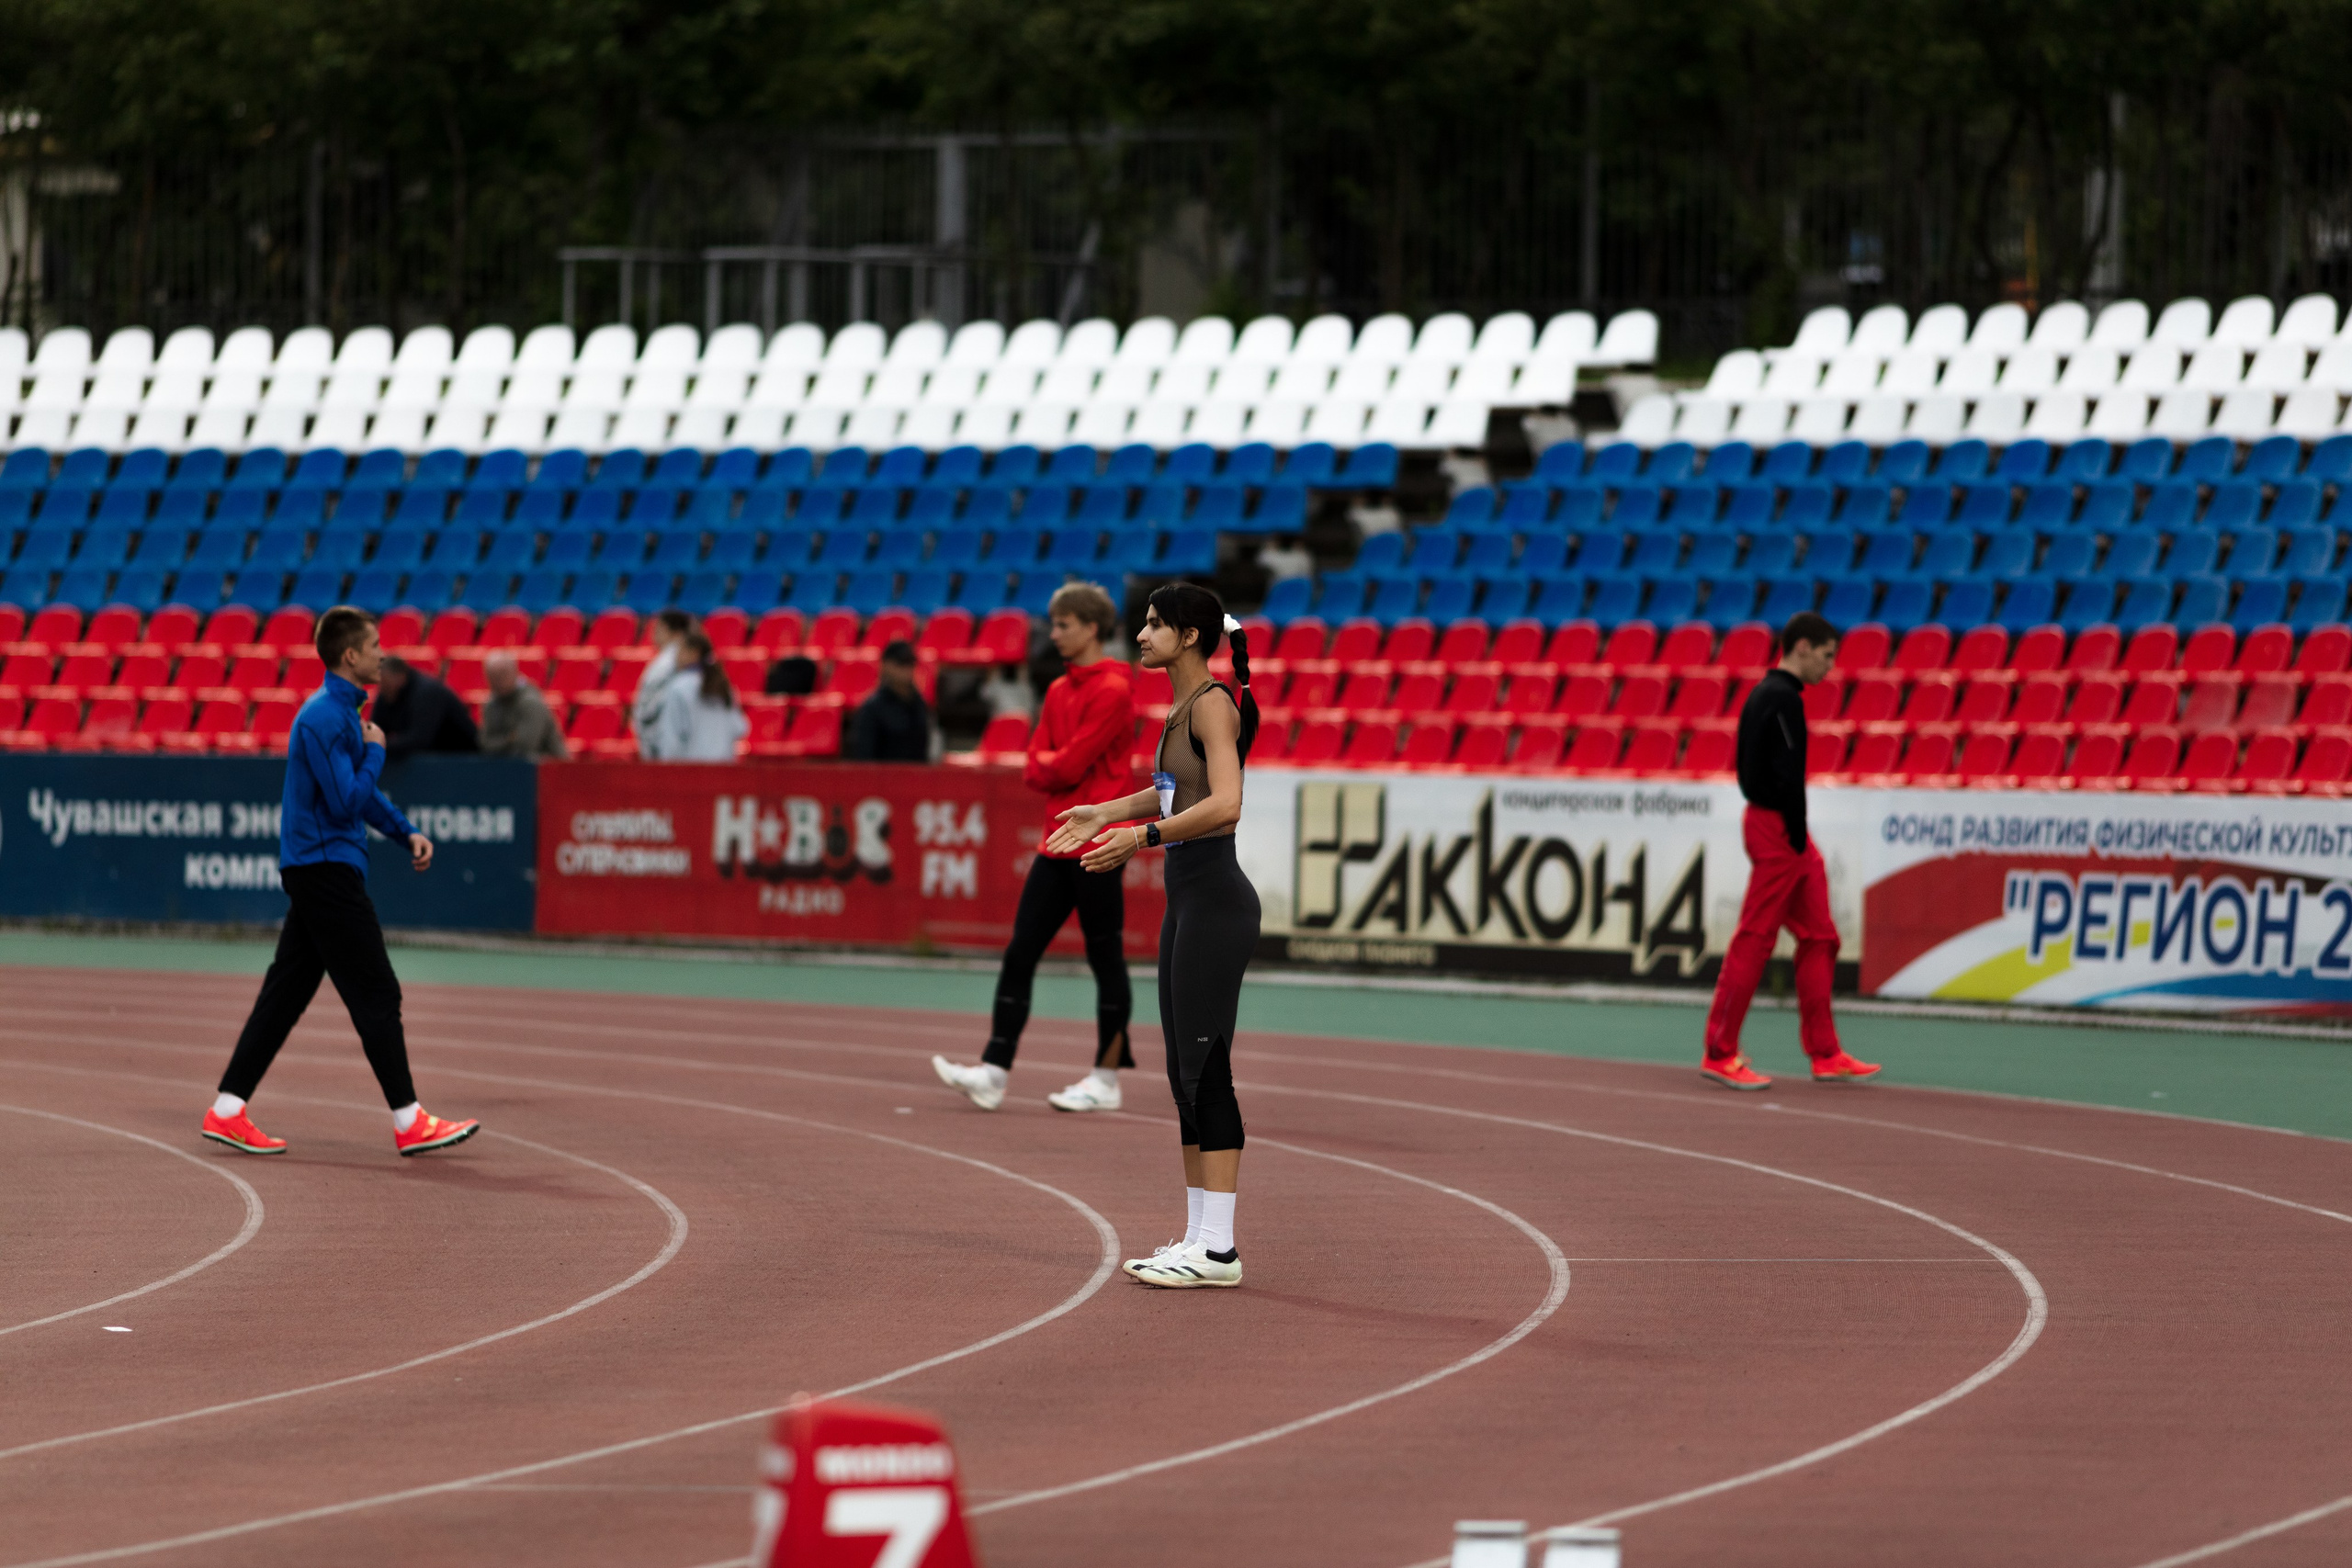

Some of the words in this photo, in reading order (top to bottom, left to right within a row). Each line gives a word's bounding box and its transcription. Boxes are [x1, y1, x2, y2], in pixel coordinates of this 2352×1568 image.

[28, 788, 222, 846] Чувашская
[1882, 814, 1954, 847] ФОНД
[1960, 816, 2088, 850] РАЗВИТИЯ
[2096, 816, 2263, 854] ФИЗИЧЕСКОЙ
[2268, 821, 2352, 855] КУЛЬТ
[186, 852, 283, 890] комп
[922, 851, 978, 898] FM
[759, 885, 843, 915] РАДИО
[2007, 877, 2301, 967] "РЕГИОН
[823, 1485, 950, 1568] 7
